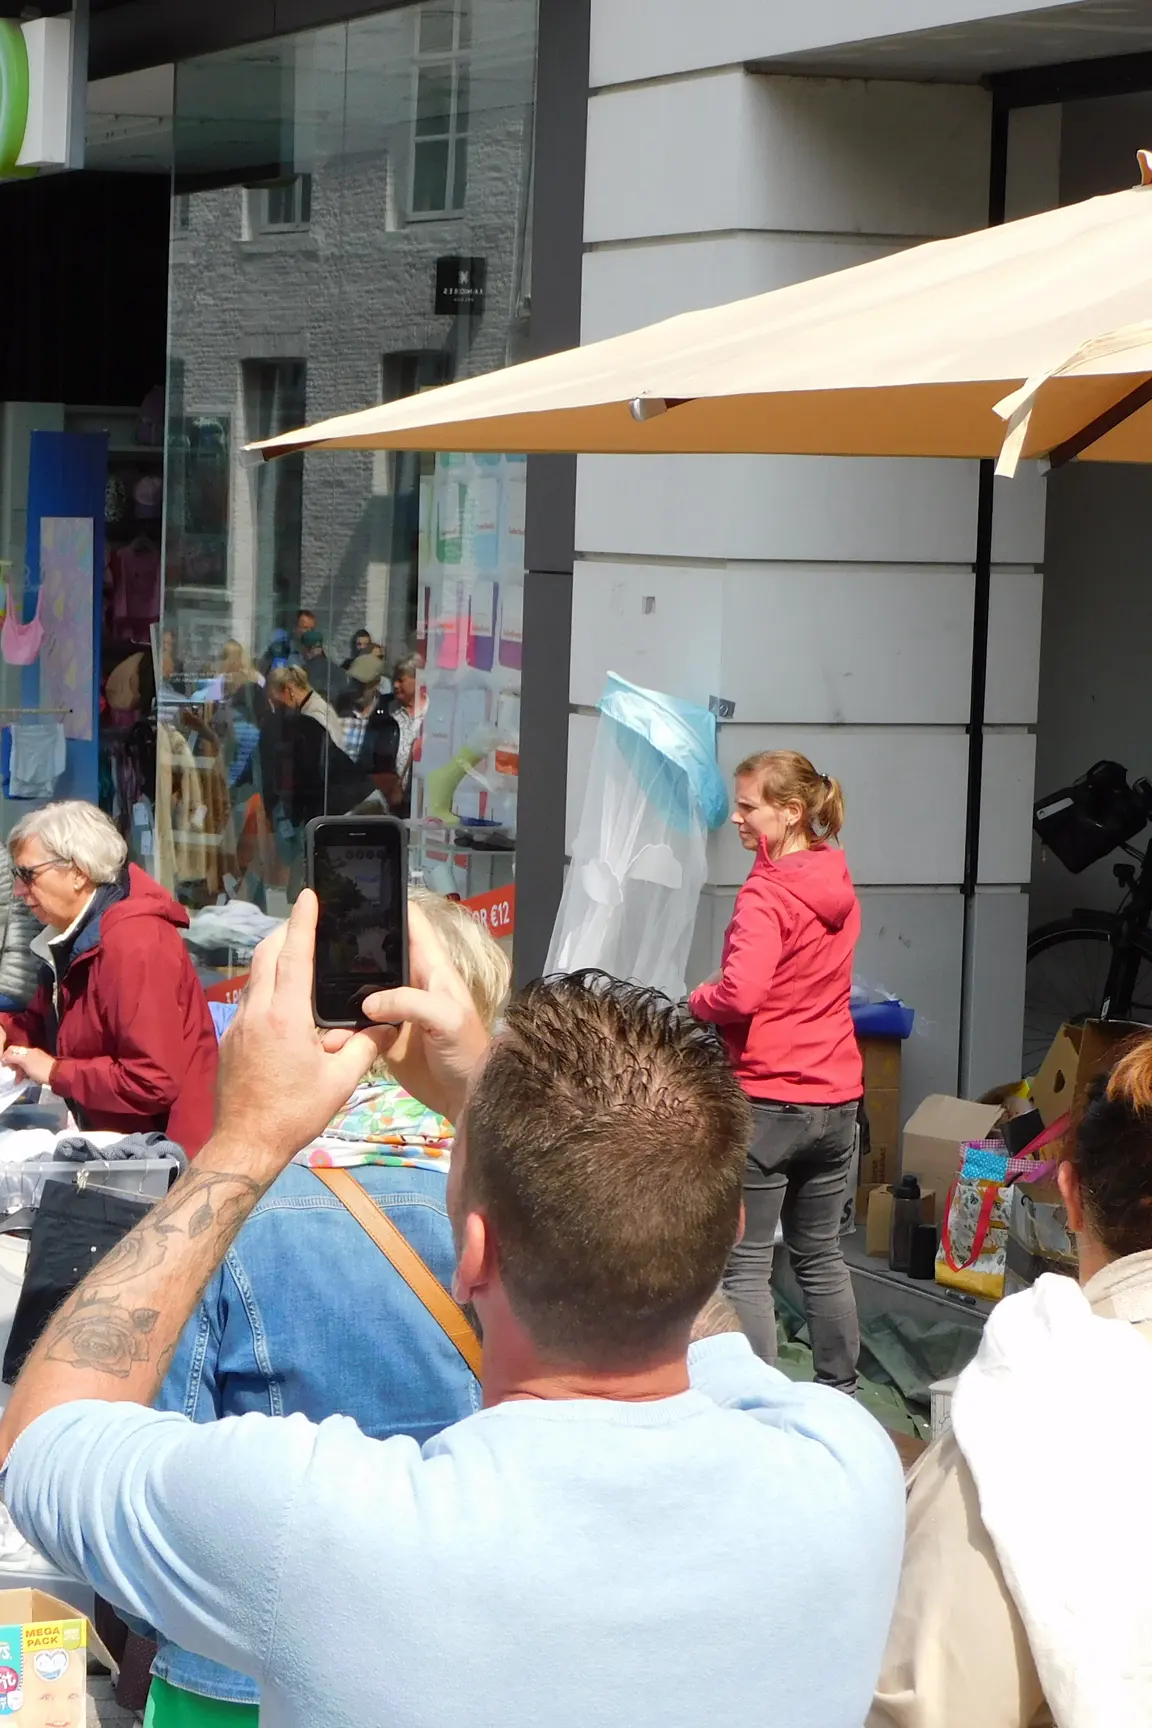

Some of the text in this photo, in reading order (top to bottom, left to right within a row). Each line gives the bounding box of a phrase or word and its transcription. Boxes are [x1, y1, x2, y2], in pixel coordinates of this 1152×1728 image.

[490, 901, 510, 927] €12
[25, 1627, 60, 1638] MEGA
[27, 1636, 58, 1648] PACK
